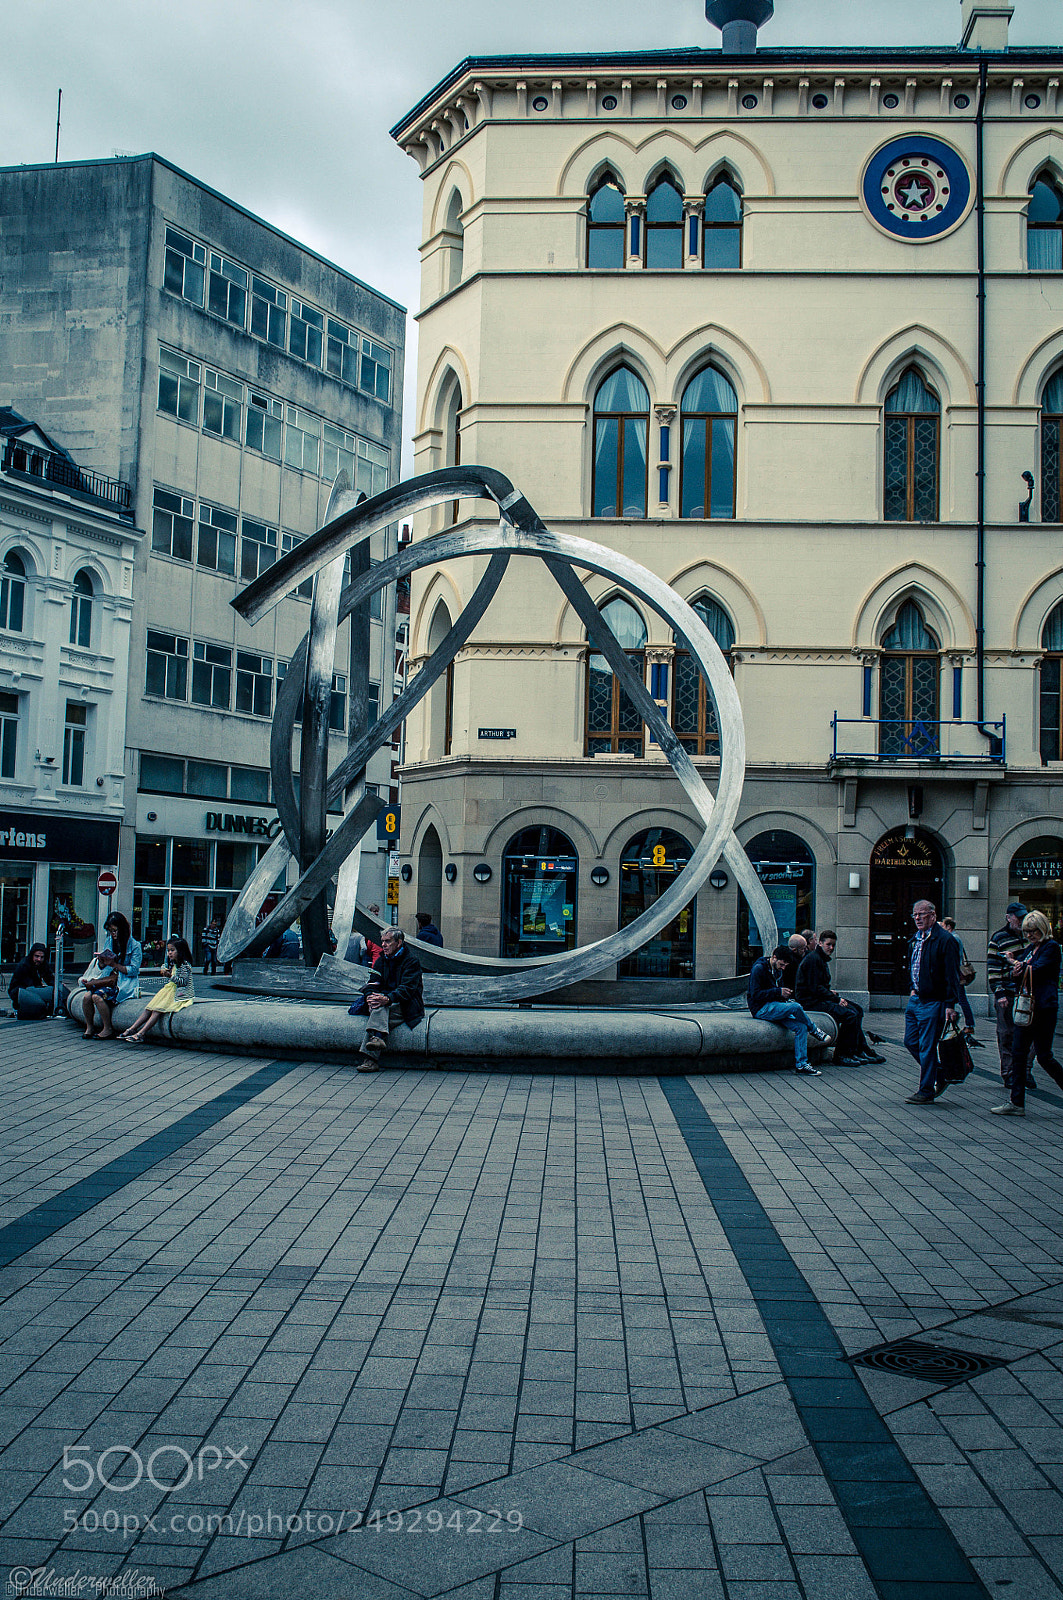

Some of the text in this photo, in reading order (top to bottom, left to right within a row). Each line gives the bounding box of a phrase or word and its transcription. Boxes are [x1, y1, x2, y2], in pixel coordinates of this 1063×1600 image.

[206, 811, 268, 836] DUNNES
[0, 827, 47, 848] rtens
[907, 858, 932, 867] SQUARE
